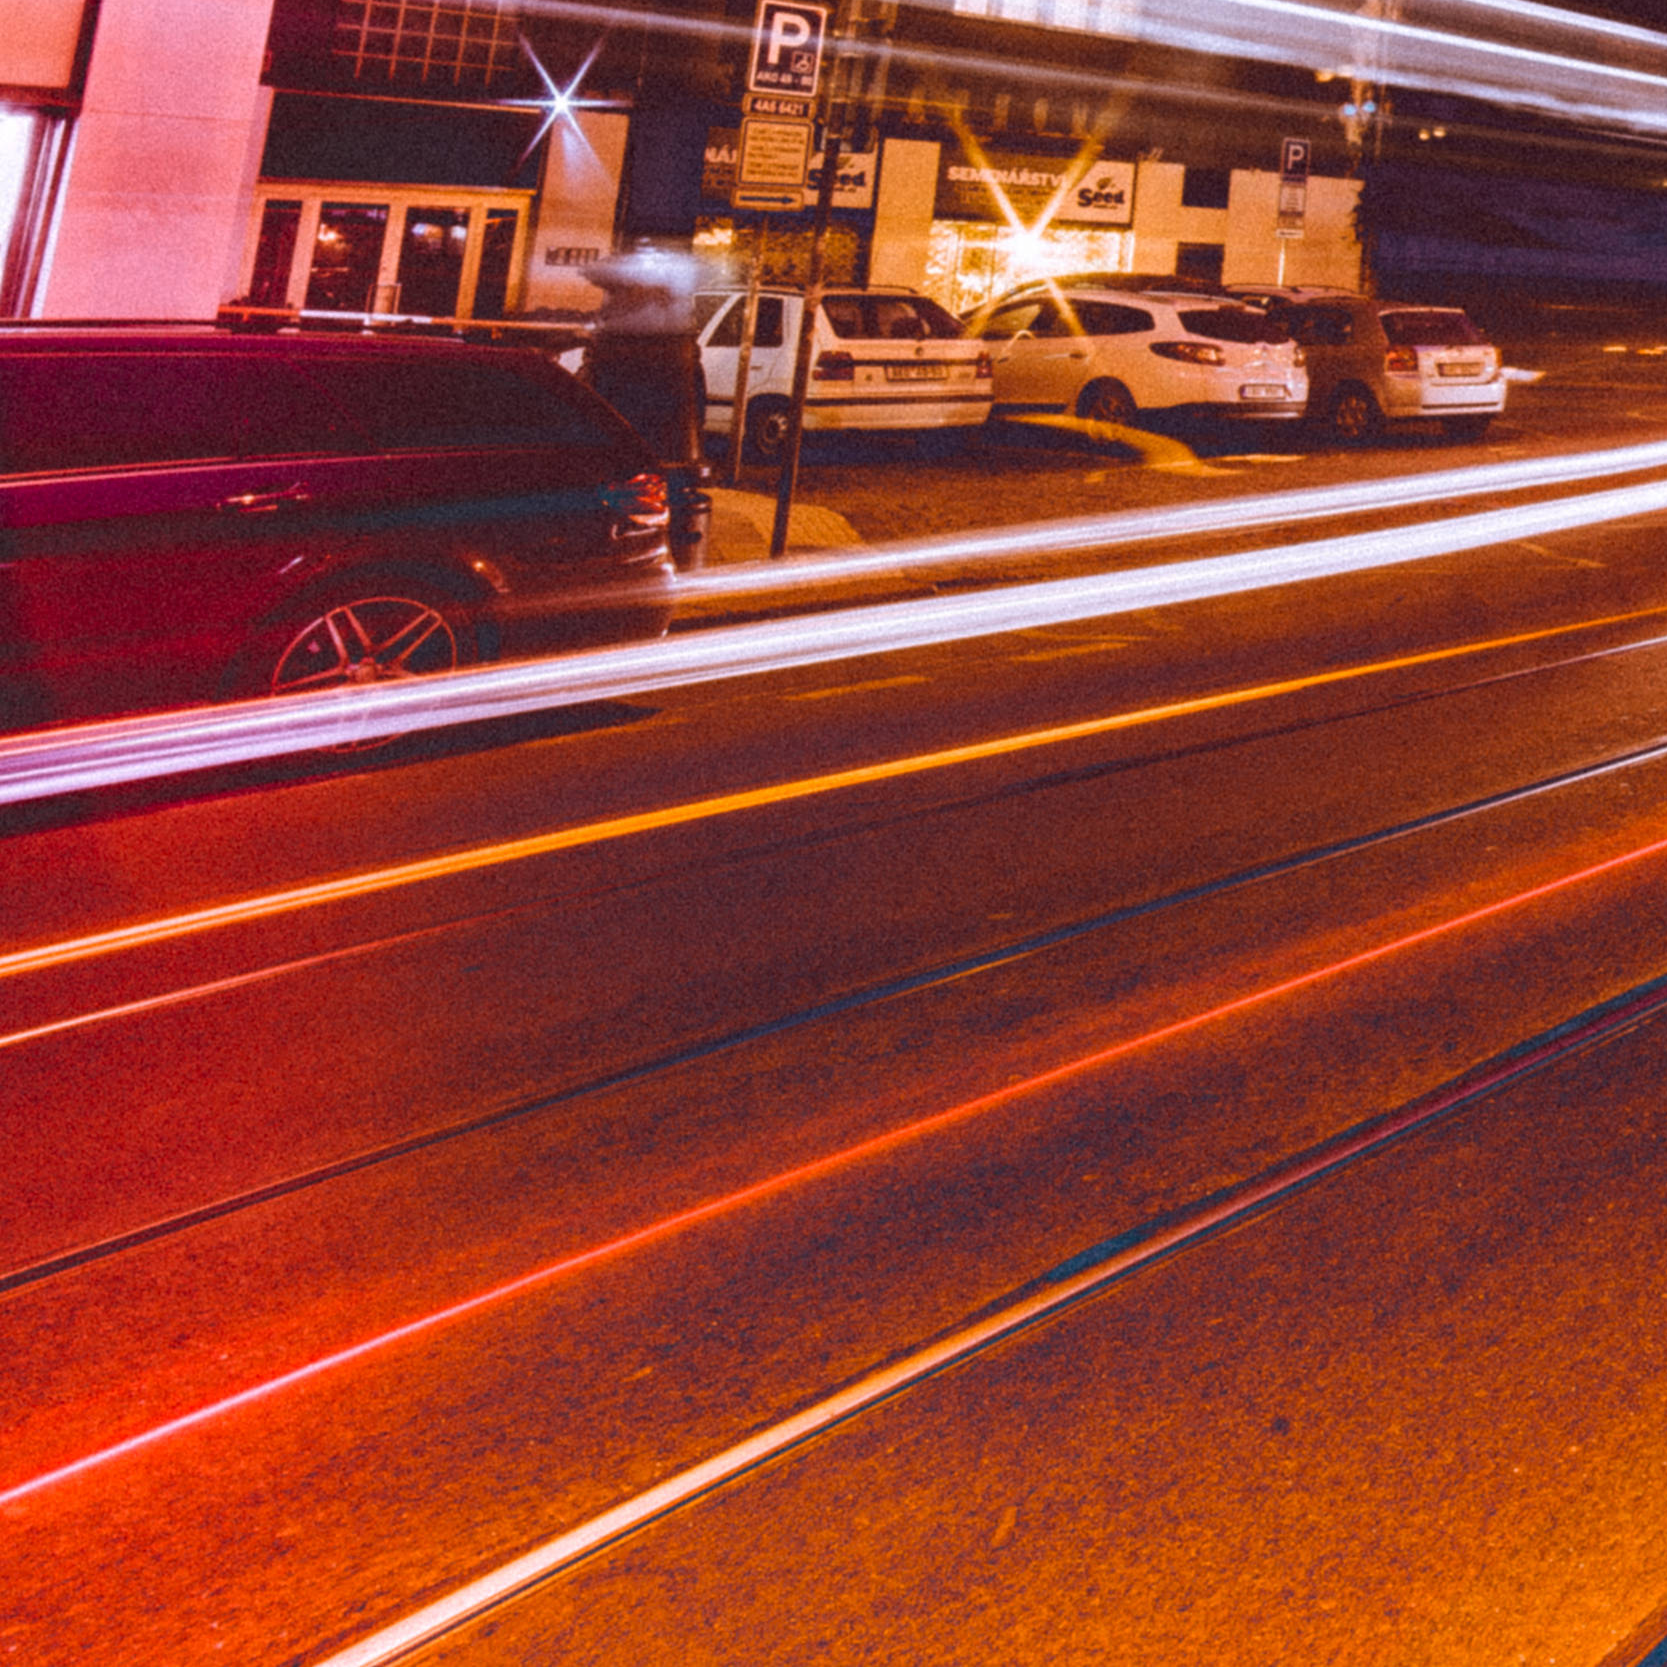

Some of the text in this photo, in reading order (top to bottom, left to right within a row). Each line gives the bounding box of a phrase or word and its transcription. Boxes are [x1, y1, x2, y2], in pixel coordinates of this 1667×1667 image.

[767, 11, 811, 65] P
[1287, 145, 1304, 170] P
[1078, 187, 1125, 208] Seed
